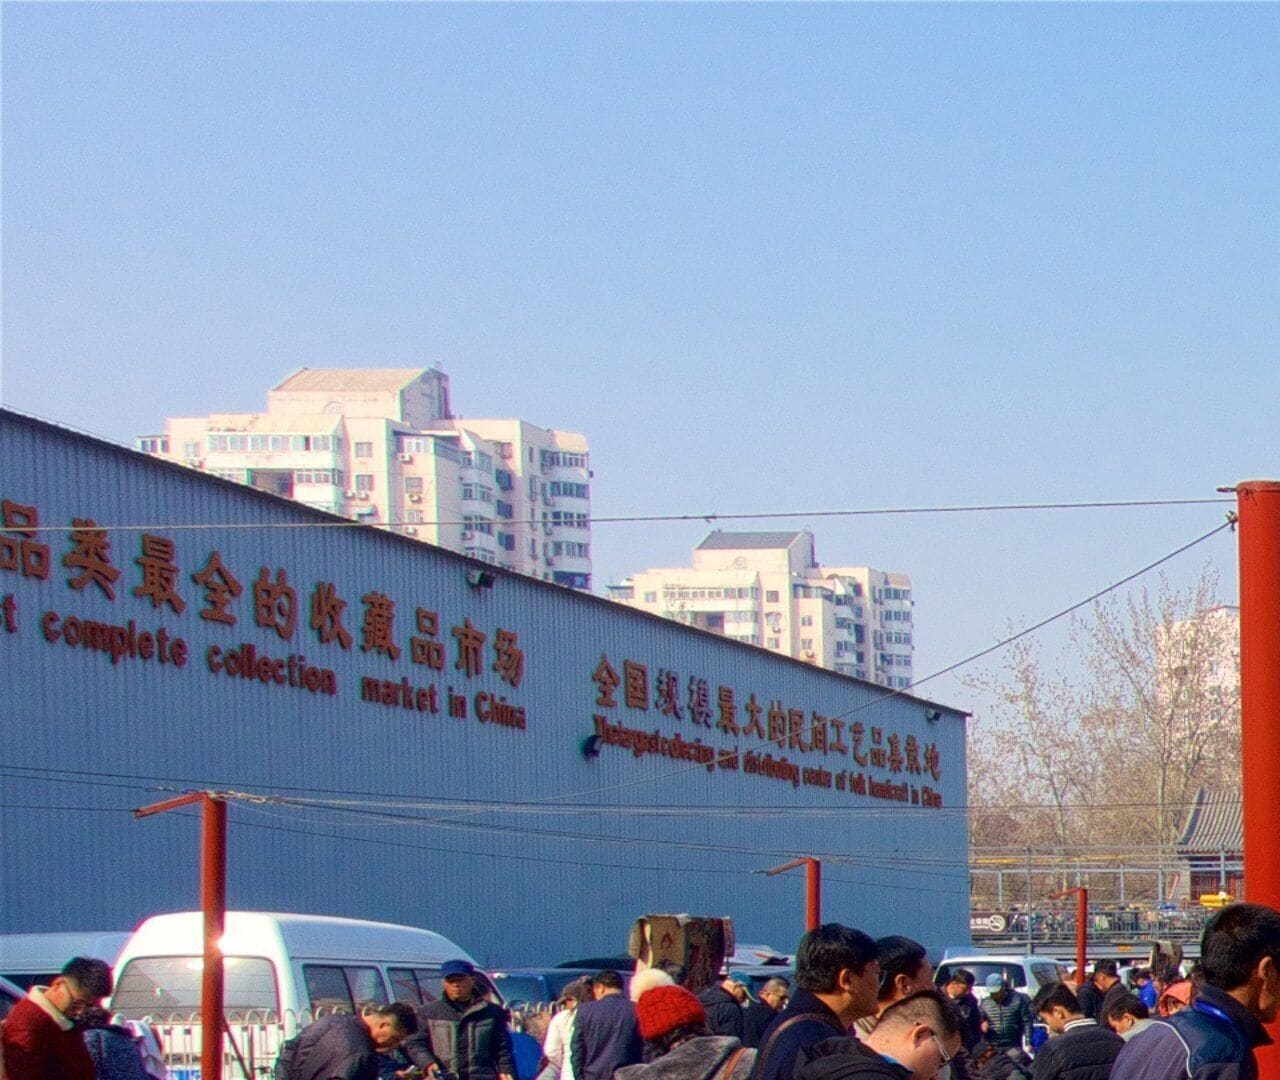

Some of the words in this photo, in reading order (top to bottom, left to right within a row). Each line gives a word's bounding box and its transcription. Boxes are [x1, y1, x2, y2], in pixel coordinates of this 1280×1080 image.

[0, 498, 526, 688] 品类最全的收藏品市场
[42, 610, 188, 667] complete
[206, 642, 337, 695] collection
[361, 676, 439, 714] market
[449, 687, 467, 719] in
[476, 691, 526, 730] China
